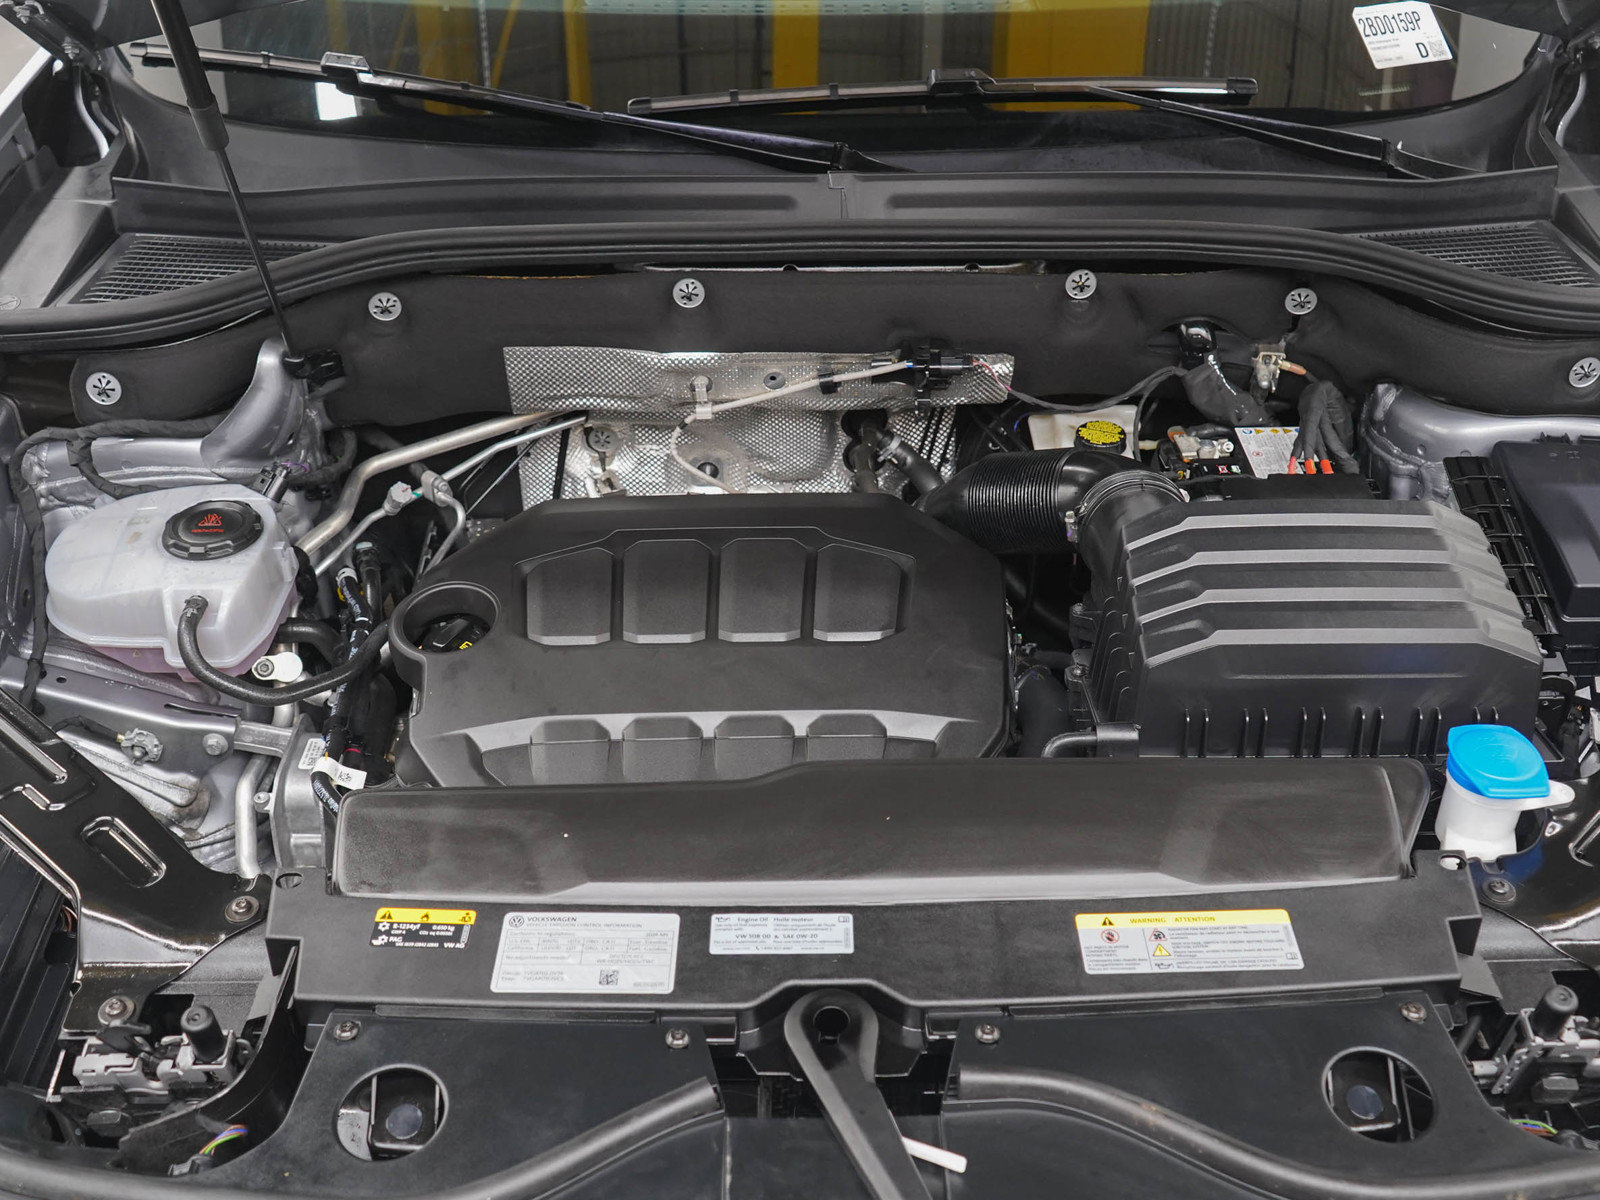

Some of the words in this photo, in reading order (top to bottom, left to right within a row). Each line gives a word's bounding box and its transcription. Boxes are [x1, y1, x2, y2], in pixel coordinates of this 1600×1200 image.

[1358, 11, 1421, 37] 2BD0159P
[1415, 42, 1429, 58] D
[392, 923, 421, 931] R-1234yf
